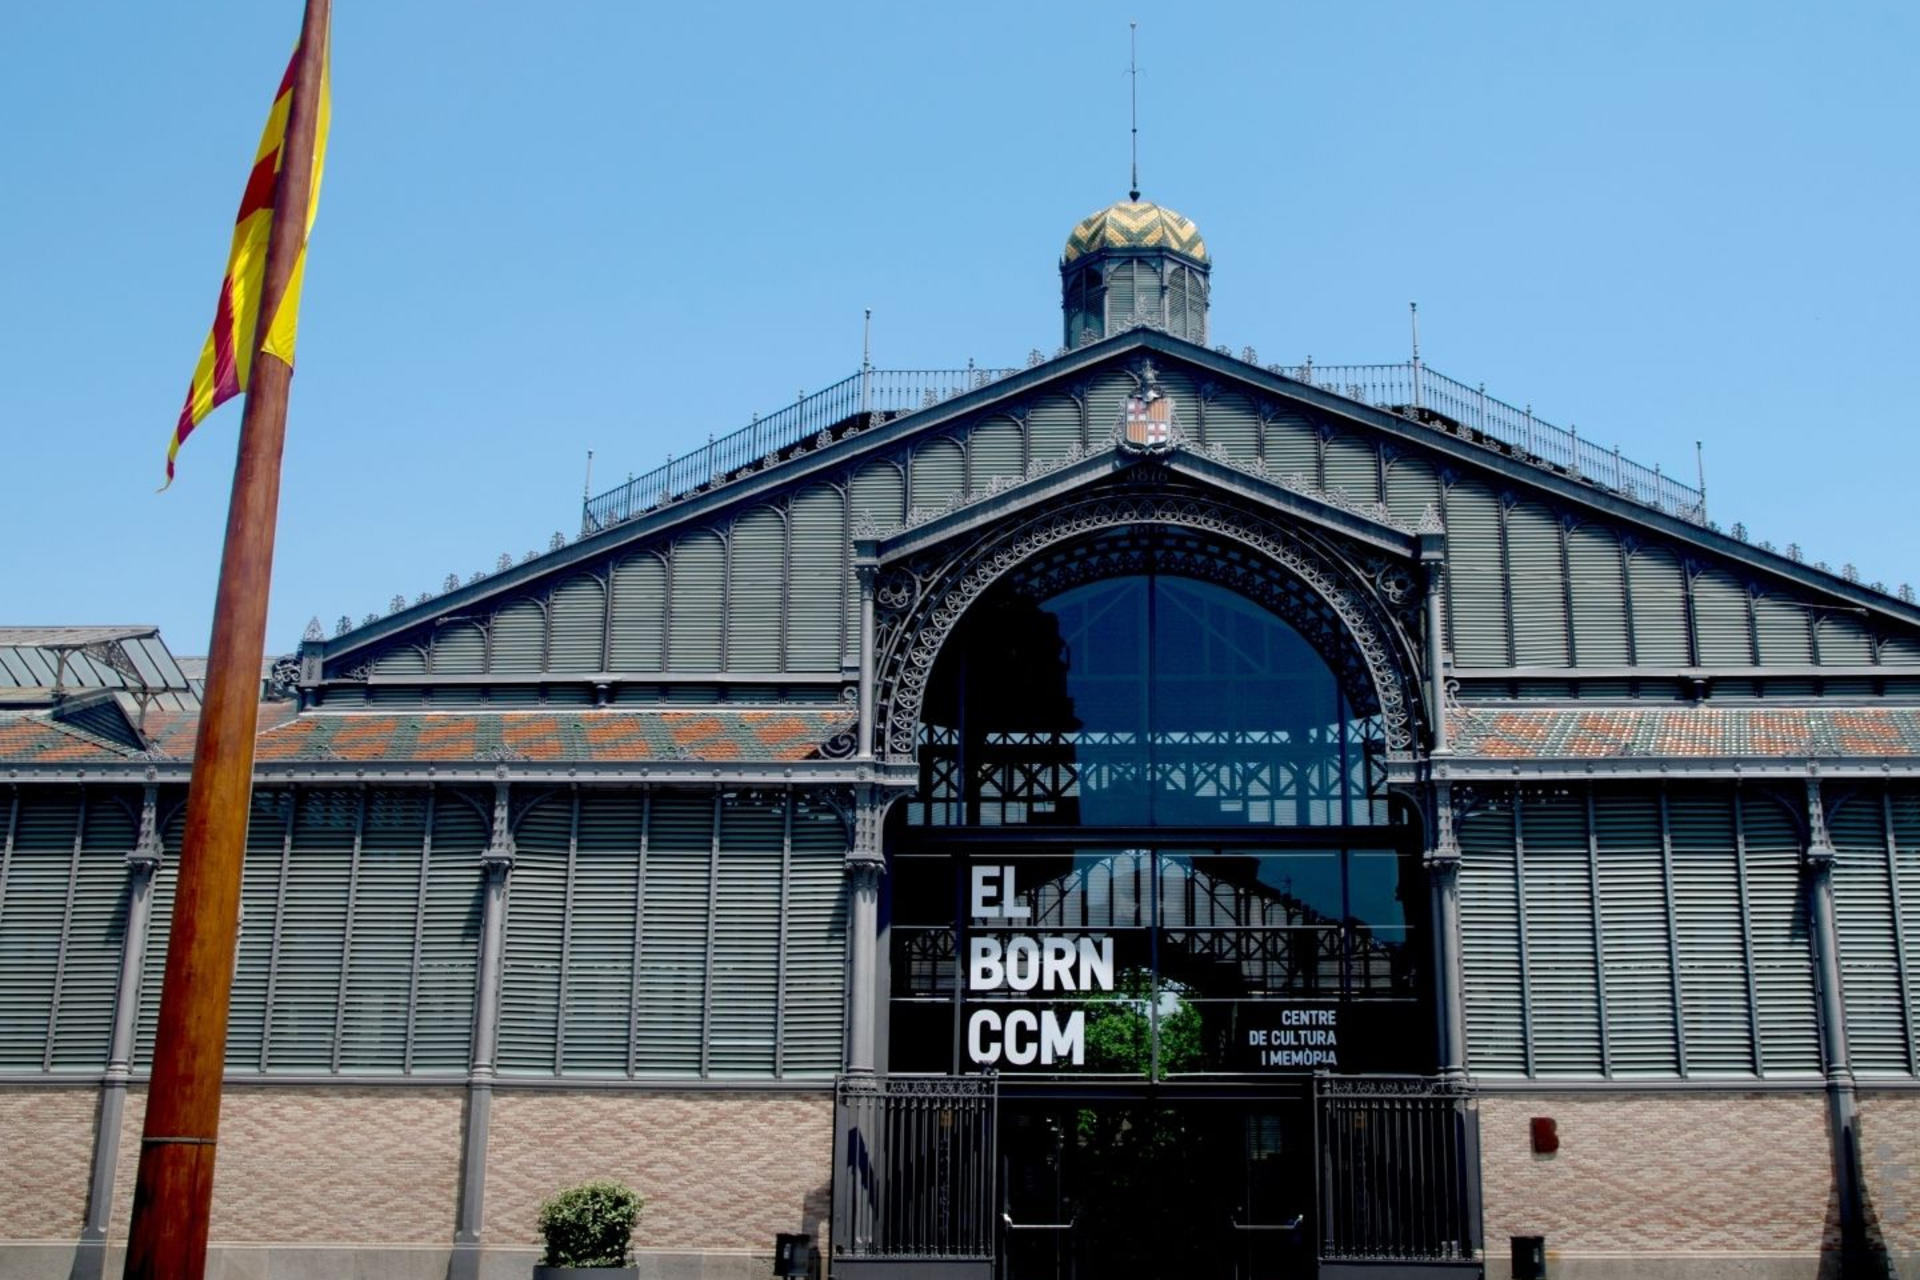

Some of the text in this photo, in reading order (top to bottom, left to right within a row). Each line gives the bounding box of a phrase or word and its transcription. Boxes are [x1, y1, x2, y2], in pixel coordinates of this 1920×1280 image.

[971, 866, 1031, 918] EL
[970, 937, 1114, 991] BORN
[1281, 1010, 1337, 1026] CENTRE
[967, 1009, 1085, 1065] CCM
[1248, 1030, 1337, 1046] DE CULTURA
[1261, 1050, 1267, 1066] I
